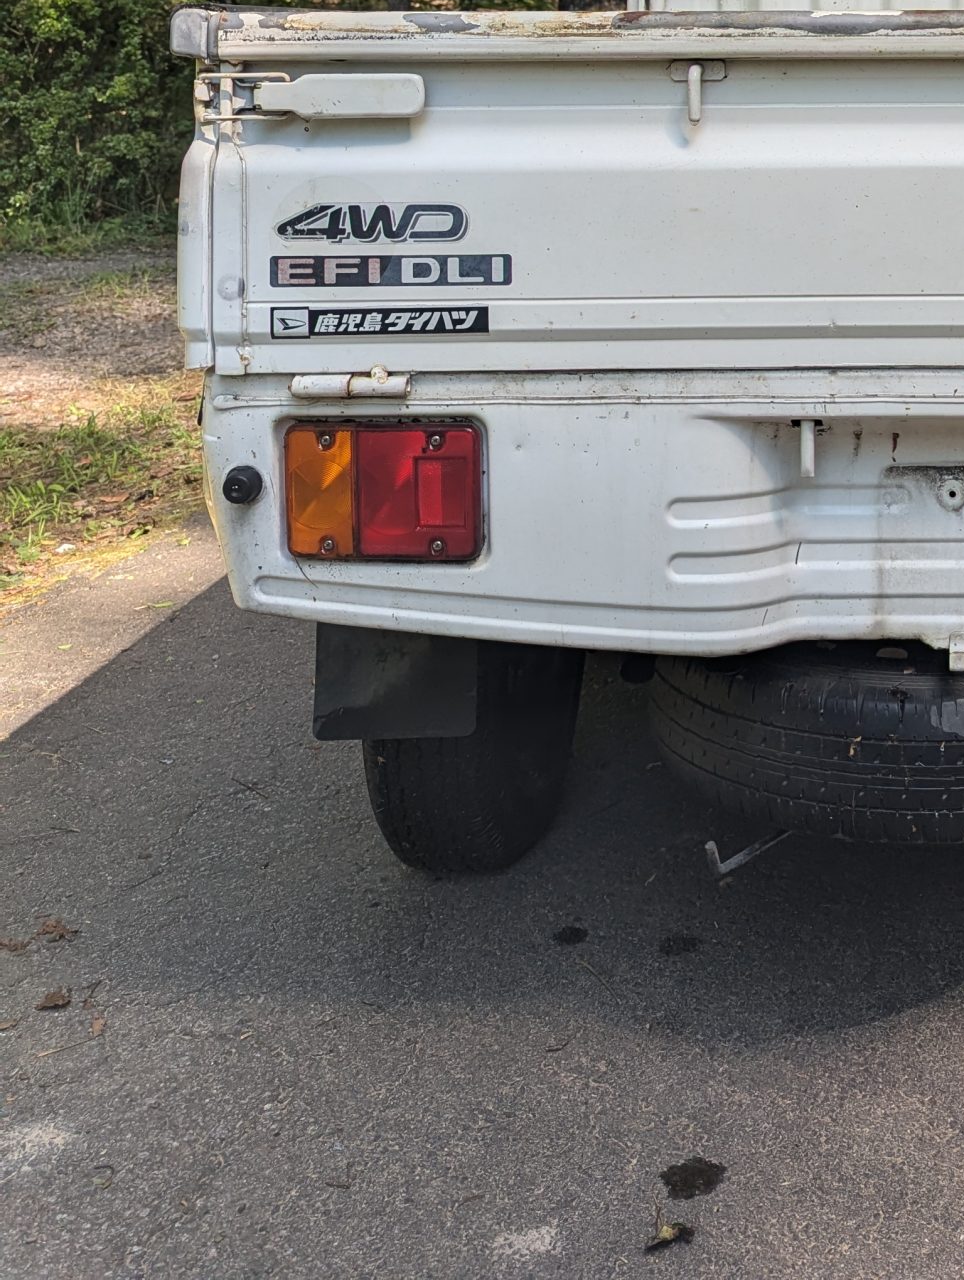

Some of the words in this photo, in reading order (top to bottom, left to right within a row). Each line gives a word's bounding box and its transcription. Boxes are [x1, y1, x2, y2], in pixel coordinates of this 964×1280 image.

[277, 204, 470, 242] 4WD
[278, 258, 381, 285] EFI
[401, 256, 504, 283] DLI
[314, 311, 478, 332] 鹿児島ダイハツ
